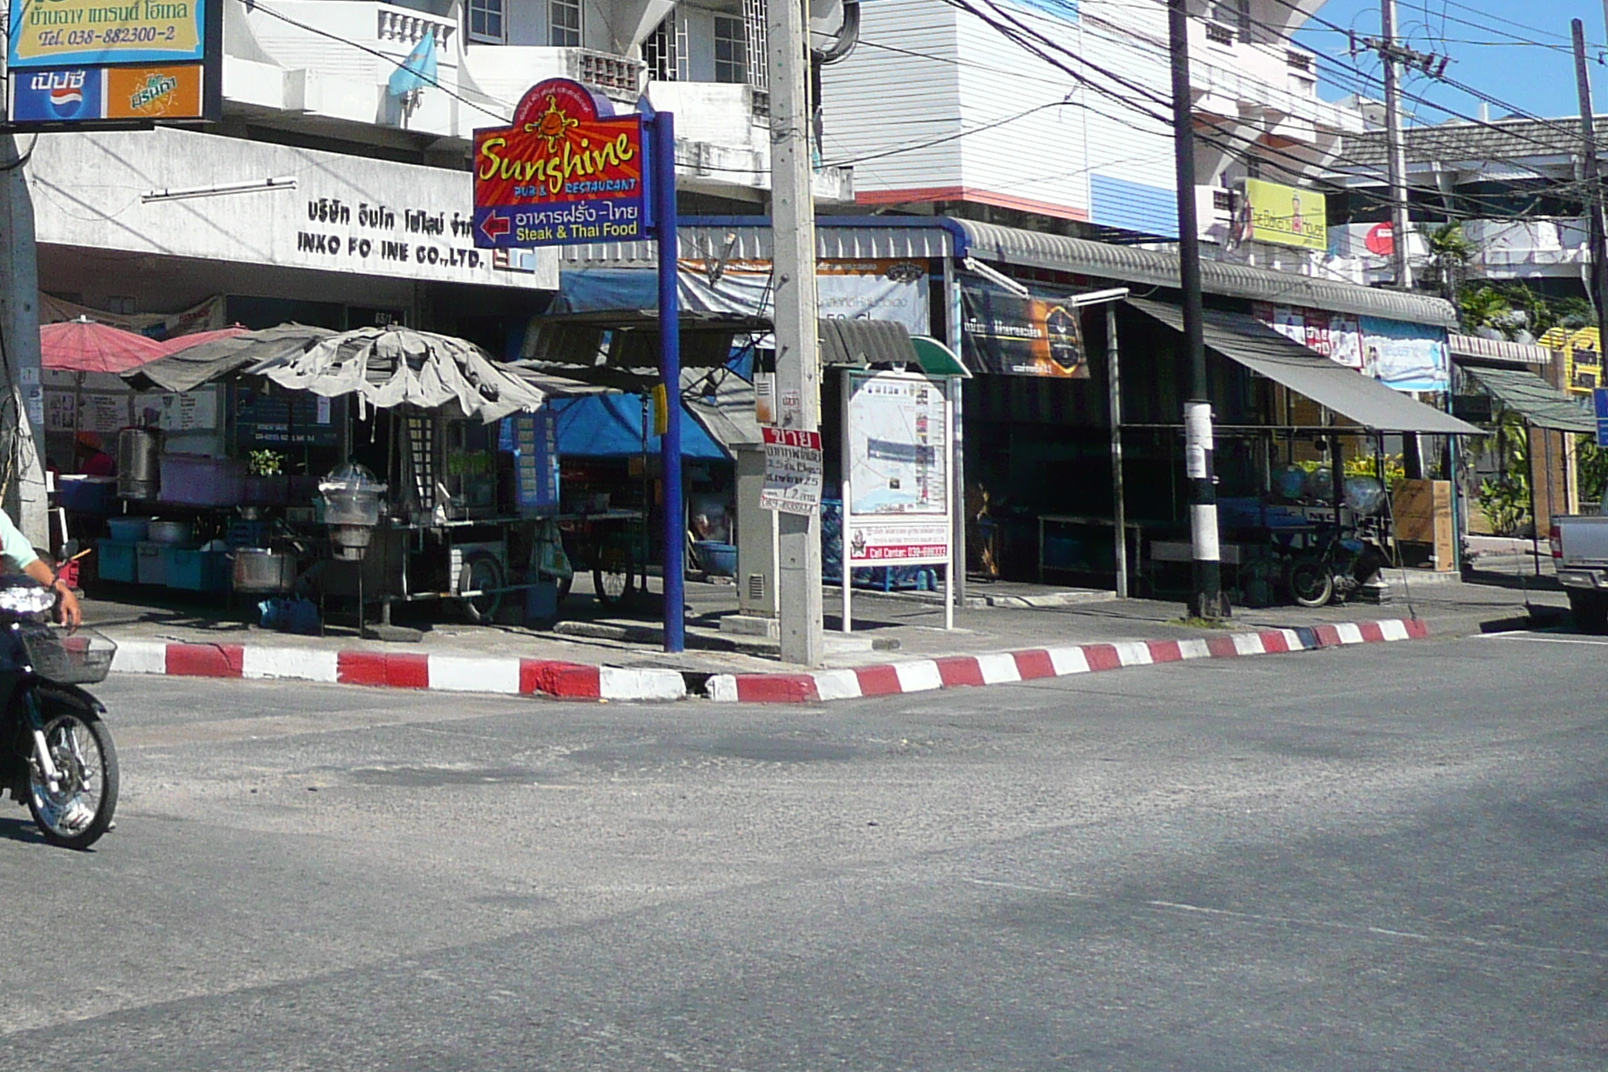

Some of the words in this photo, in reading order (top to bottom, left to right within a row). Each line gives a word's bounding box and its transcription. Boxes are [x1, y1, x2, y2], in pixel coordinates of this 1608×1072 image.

[31, 6, 83, 26] บ้านฉาง
[89, 0, 140, 23] แกรนด์
[145, 0, 188, 19] โฮเทล
[38, 28, 64, 46] Tel.
[68, 25, 175, 45] 038-882300-2
[479, 132, 635, 194] Sunshine
[513, 185, 536, 197] PUB
[564, 178, 637, 194] RESTAURANT
[308, 197, 350, 226] บริษัท
[297, 231, 341, 255] INKO
[516, 226, 553, 242] Steak
[556, 227, 567, 239] &
[570, 225, 600, 238] Thai
[603, 222, 638, 236] Food
[771, 430, 812, 447] ขาย
